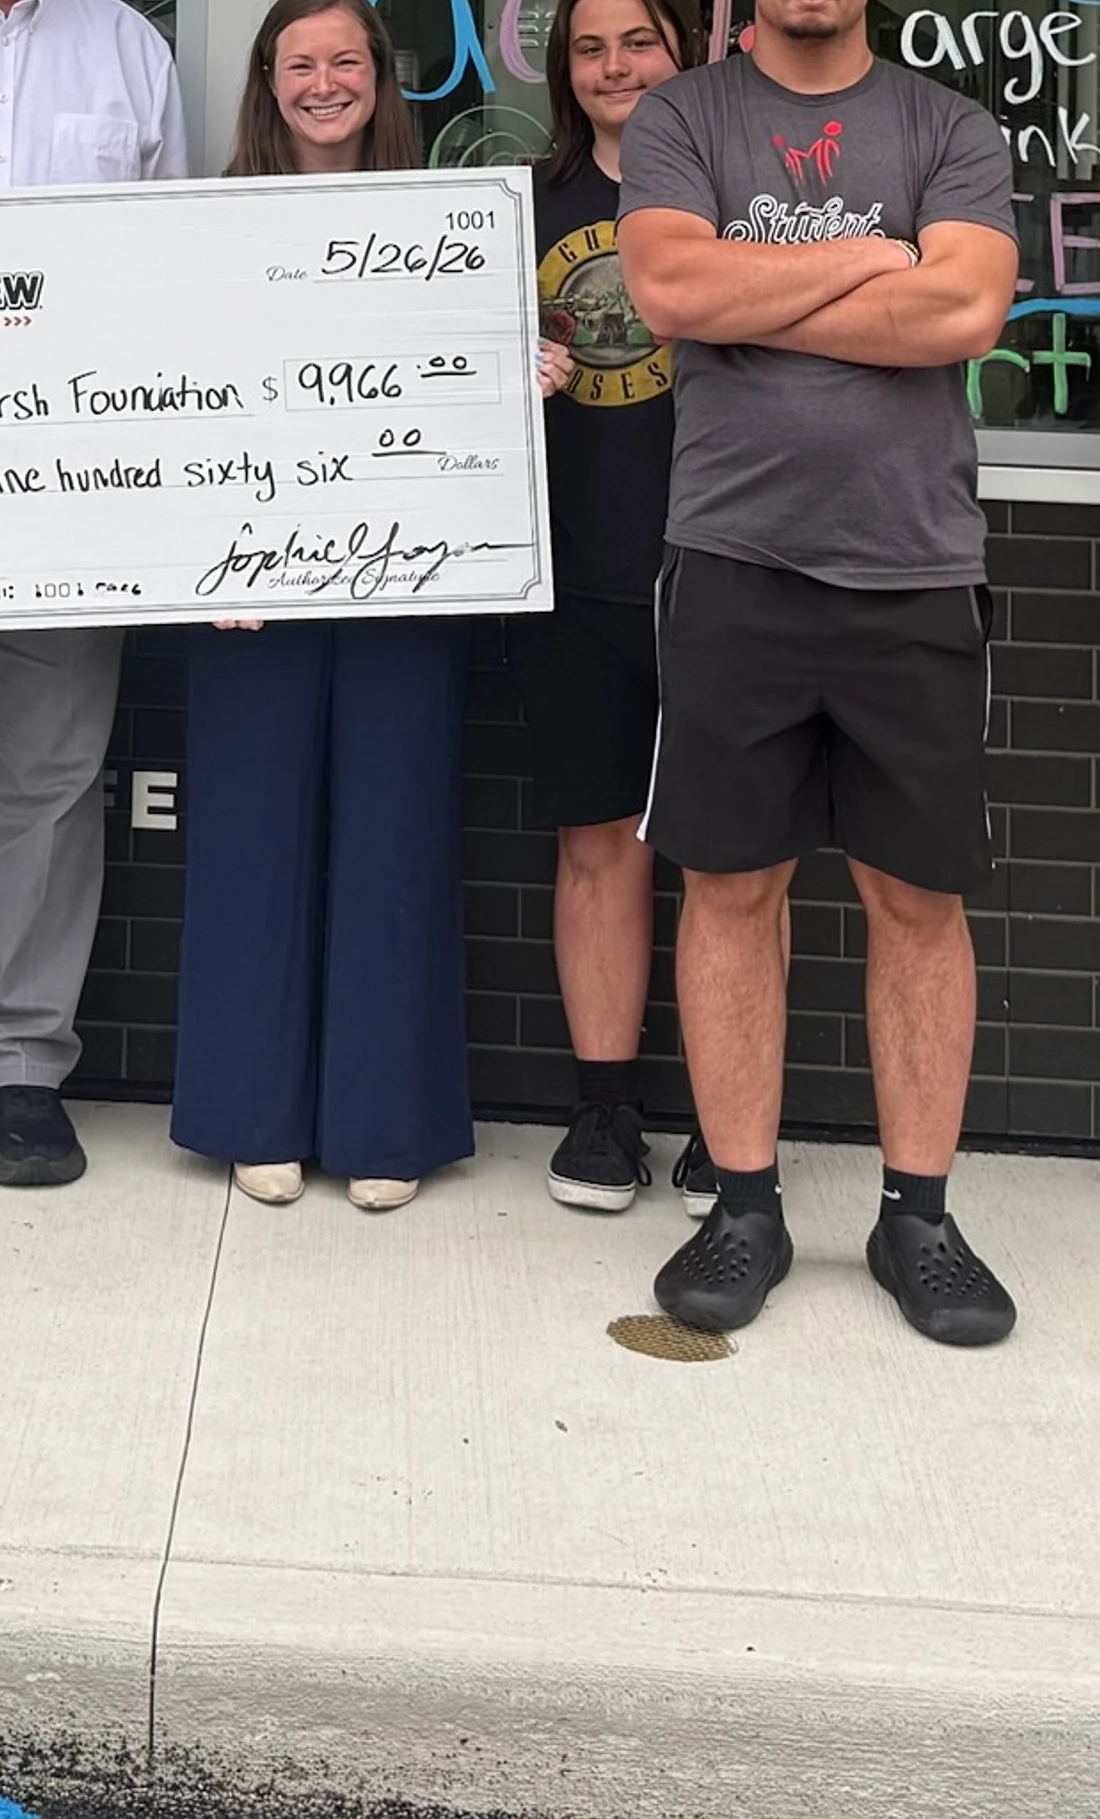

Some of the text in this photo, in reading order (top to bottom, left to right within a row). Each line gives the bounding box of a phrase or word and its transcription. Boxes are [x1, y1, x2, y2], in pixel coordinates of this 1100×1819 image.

[445, 211, 495, 230] 1001
[321, 233, 486, 281] 5/26/26
[266, 266, 308, 282] Date
[262, 376, 279, 402] $
[437, 455, 500, 472] Dollars
[55, 458, 163, 493] hundred
[184, 452, 277, 503] sixty
[296, 451, 355, 486] six
